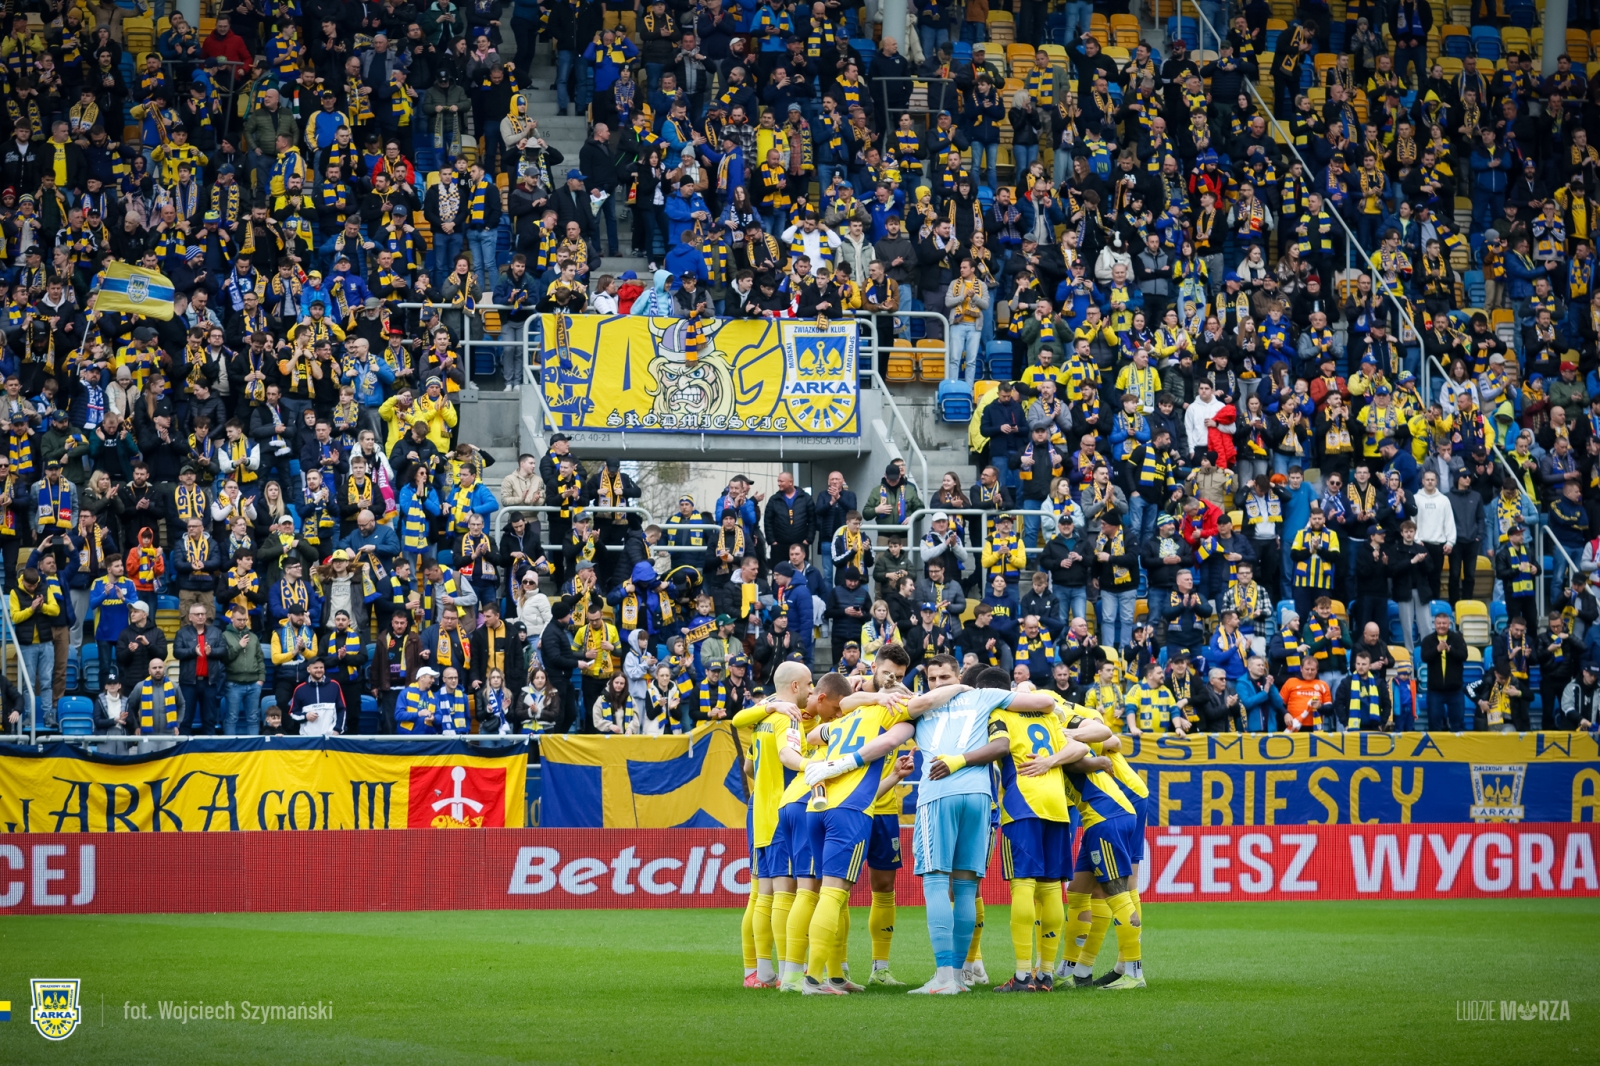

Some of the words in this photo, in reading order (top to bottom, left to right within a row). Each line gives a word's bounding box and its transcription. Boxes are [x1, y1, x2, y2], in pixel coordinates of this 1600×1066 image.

[786, 342, 795, 369] MORSKI
[846, 336, 855, 373] SPORTOWY
[791, 382, 851, 394] ARKA
[606, 408, 788, 431] ŚRÓDMIEŚCIE
[588, 433, 611, 442] 40-21
[828, 717, 866, 762] 24
[923, 709, 978, 751] 77
[1027, 723, 1054, 757] 8
[48, 770, 241, 833] ARKA
[1480, 808, 1515, 816] ARKA
